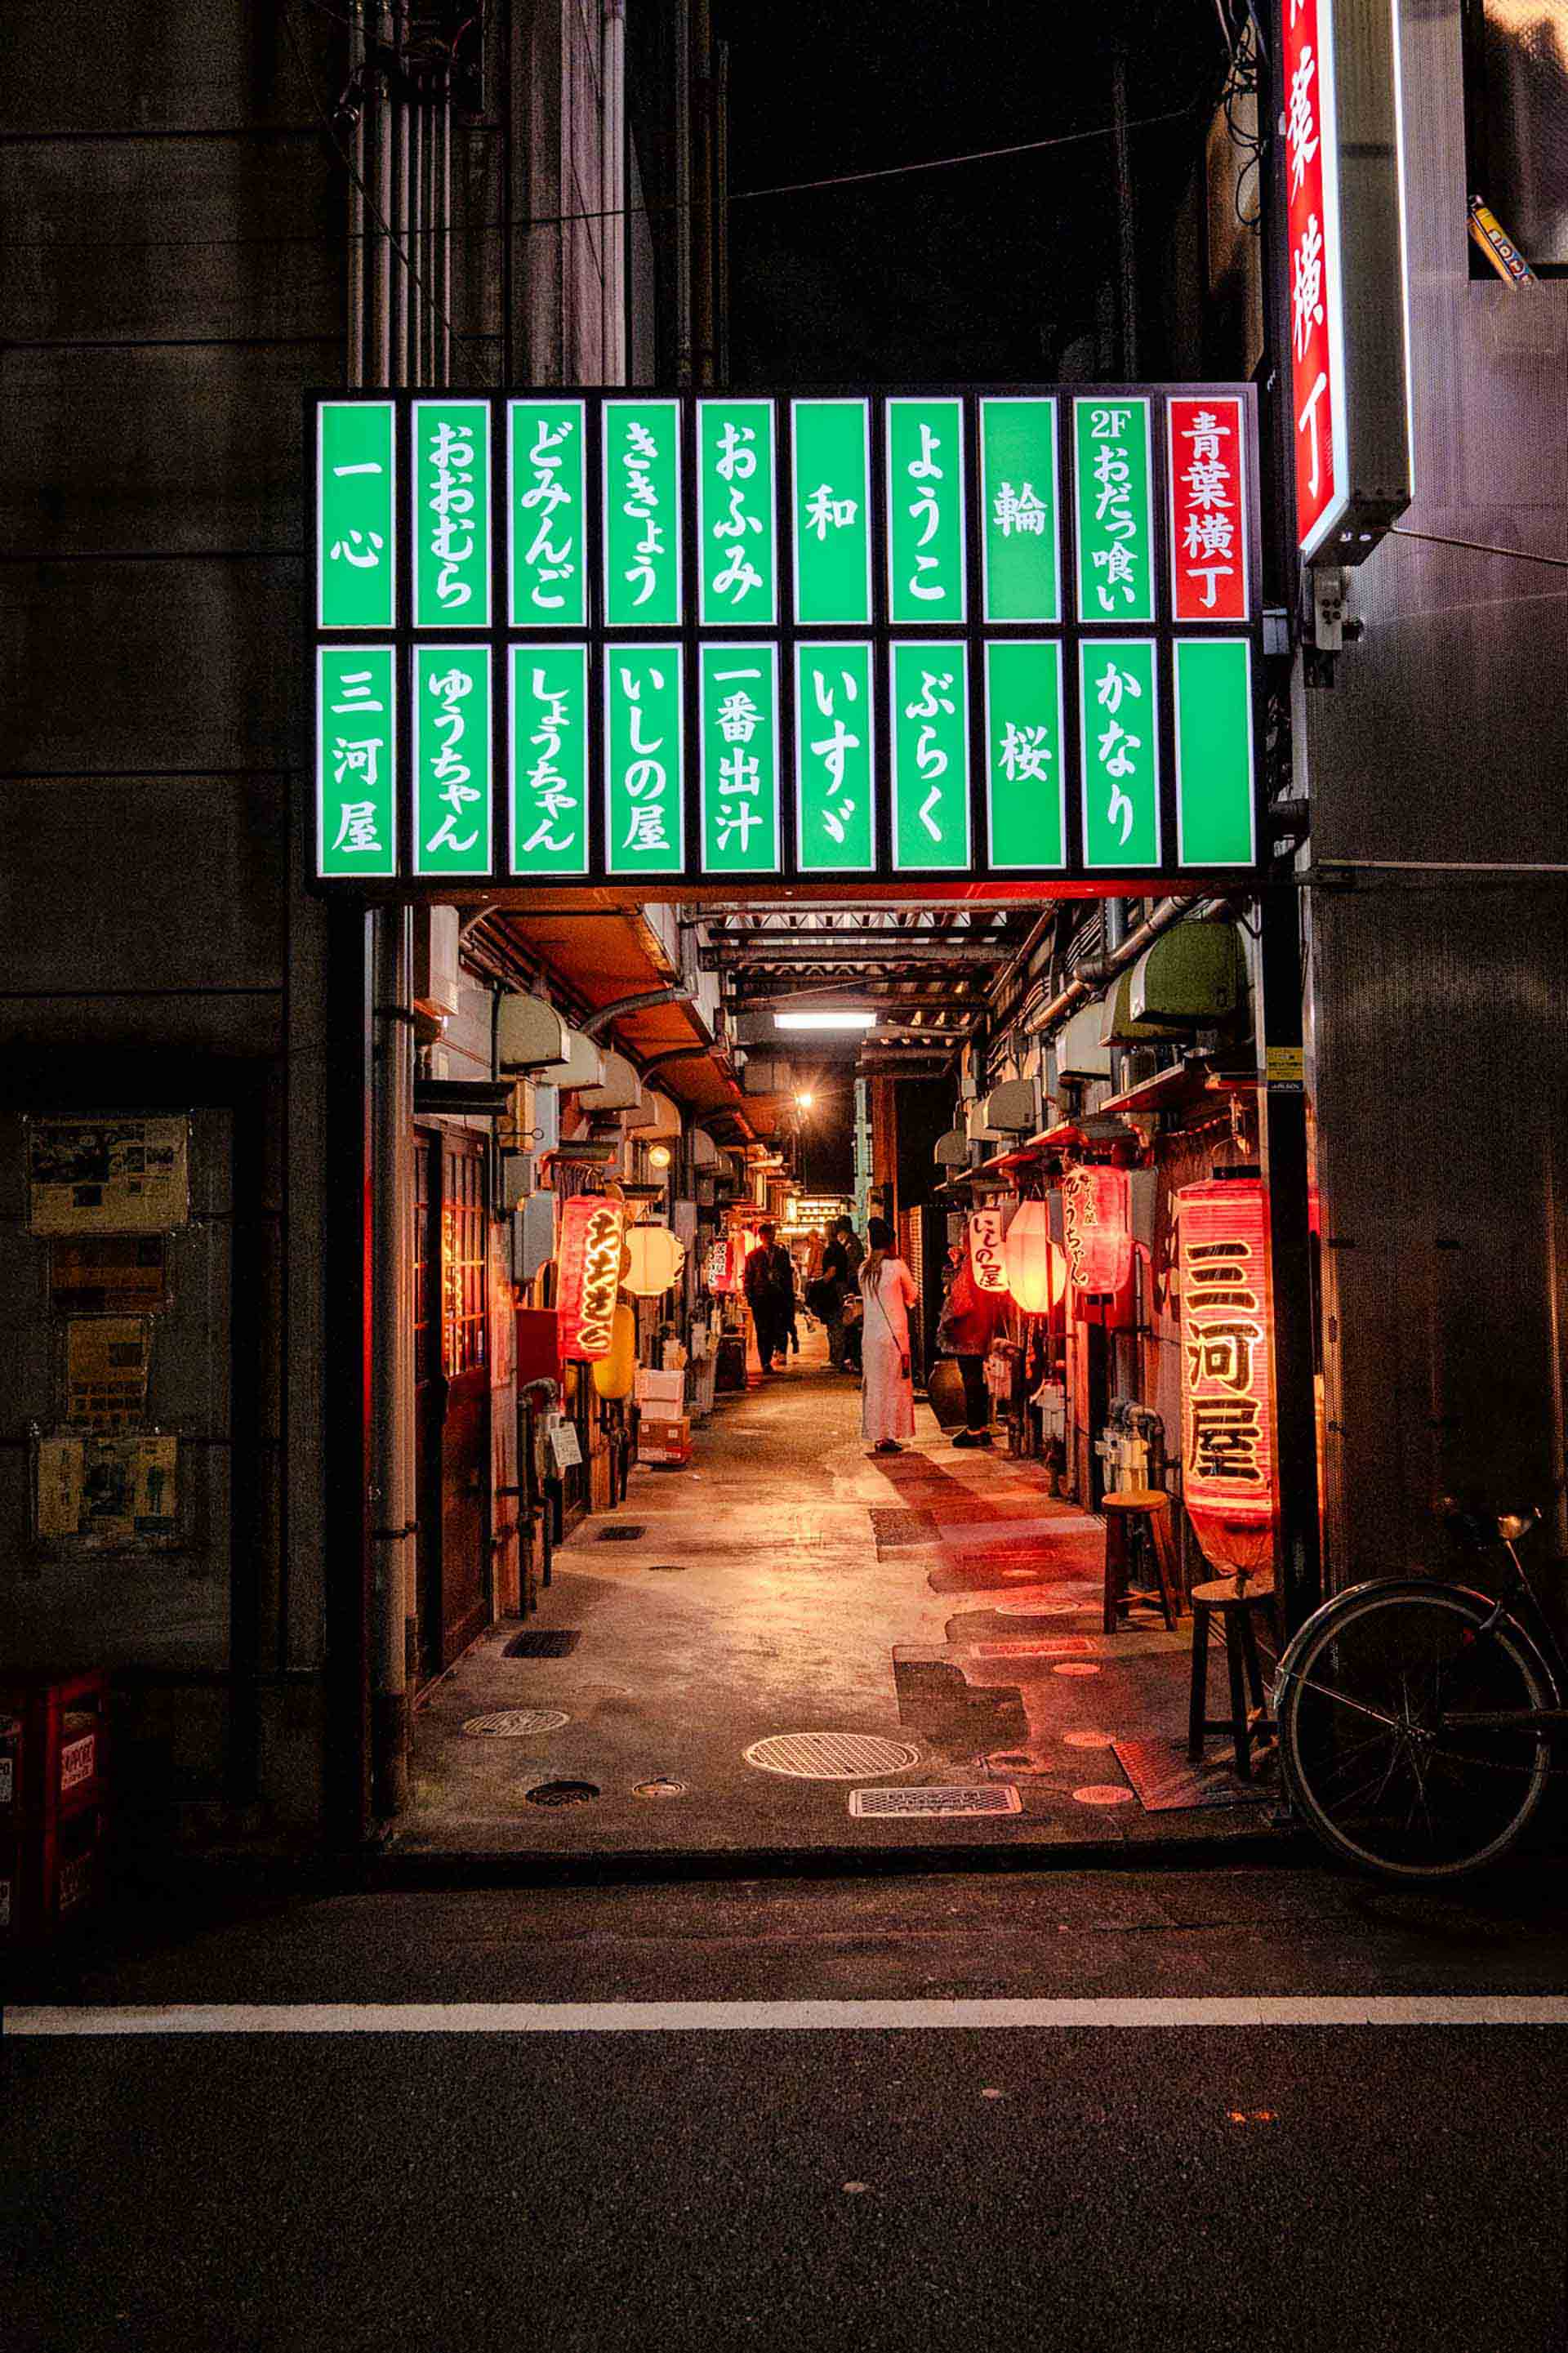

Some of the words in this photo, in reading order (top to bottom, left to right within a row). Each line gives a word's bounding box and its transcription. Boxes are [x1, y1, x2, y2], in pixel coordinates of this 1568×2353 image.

[1286, 0, 1327, 497] 葉横丁
[331, 463, 383, 568] 一心
[430, 423, 475, 608] おおむら
[522, 421, 574, 608] どみんご
[623, 422, 665, 606] ききょう
[713, 423, 764, 604] おふみ
[805, 484, 858, 541] 和
[908, 424, 945, 600] ようこ
[993, 482, 1047, 537] 輪
[1090, 410, 1132, 439] 2F
[1181, 411, 1236, 608] 青葉横丁
[332, 671, 384, 853] 三河屋
[426, 669, 480, 852] ゆうちゃん
[523, 668, 577, 852] しょうちゃん
[621, 668, 670, 851] いしの屋
[713, 668, 765, 853] 一番出汁
[905, 671, 956, 842] ぶらく
[999, 723, 1052, 782] 桜
[1096, 662, 1142, 845] かなり
[973, 1218, 1005, 1288] いしの屋
[1065, 1175, 1087, 1286] ゆうちゃん
[1187, 1241, 1263, 1482] 三河屋
